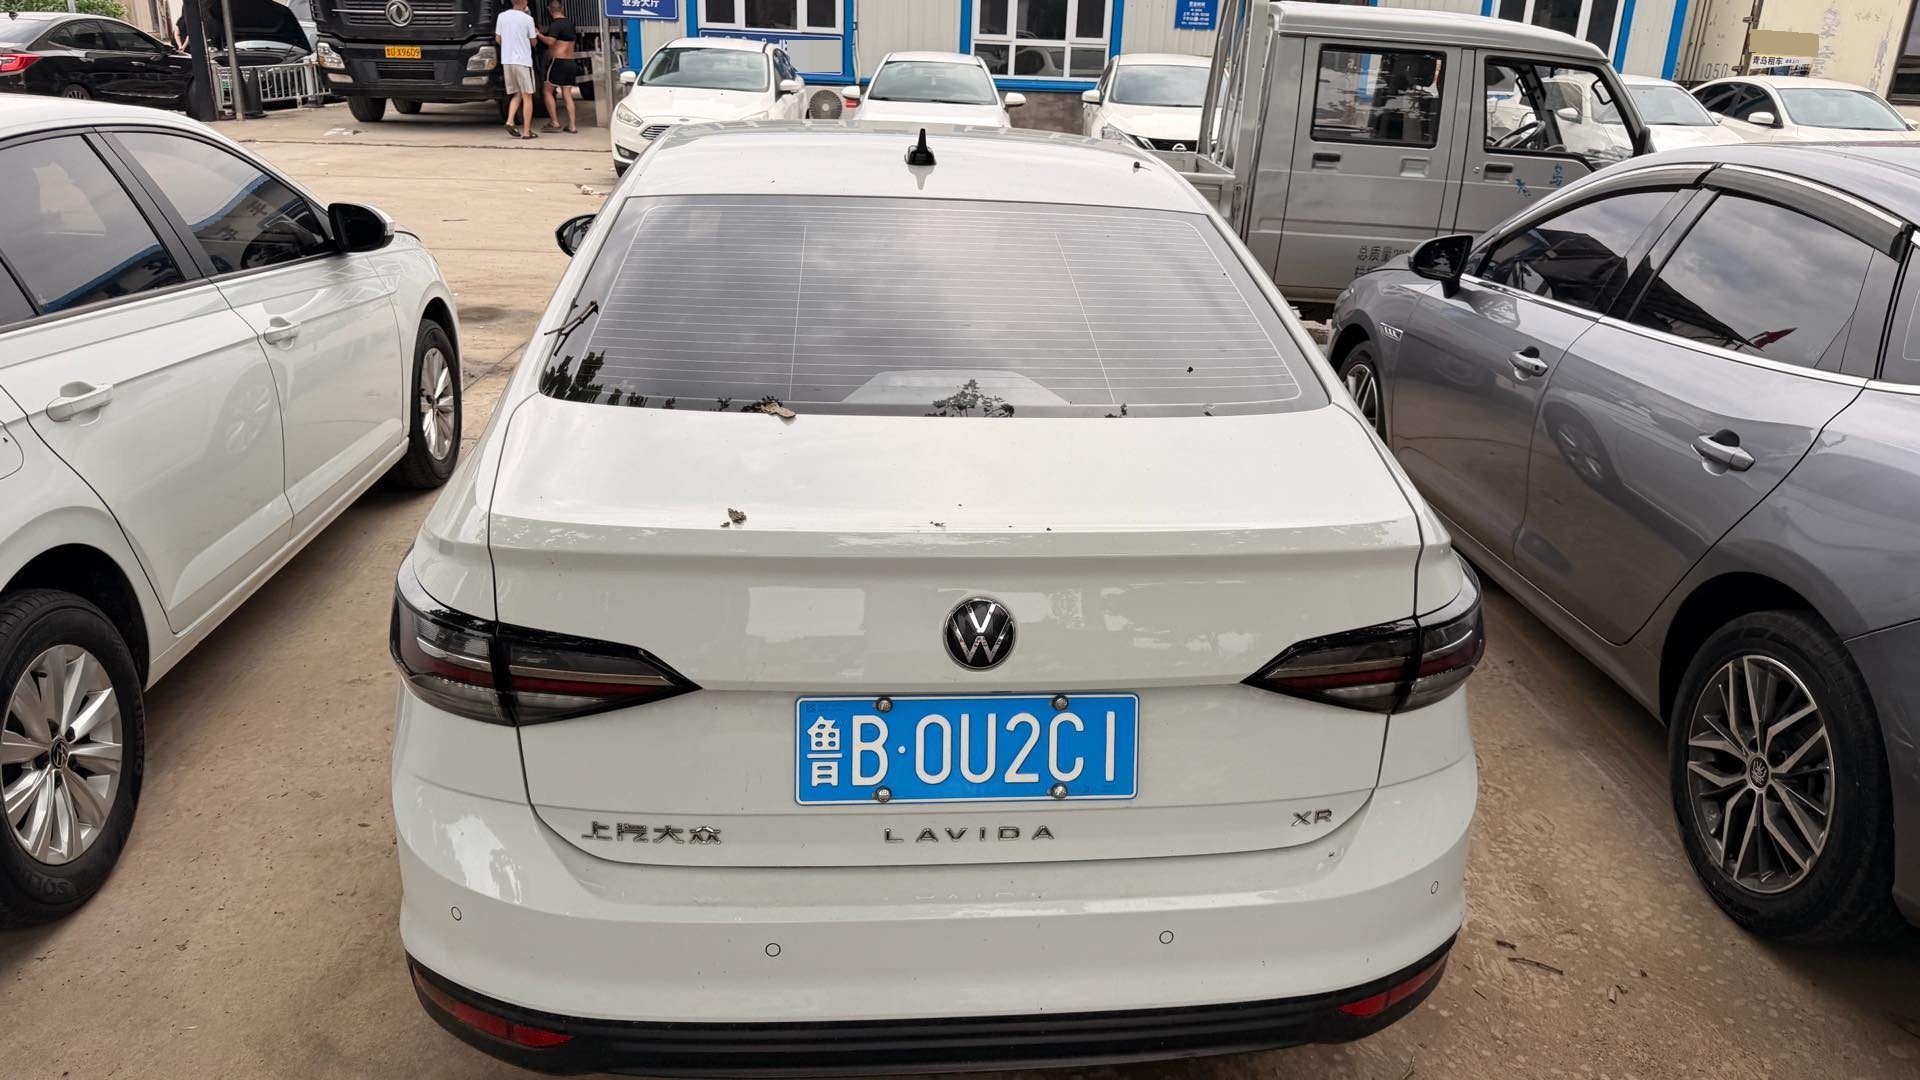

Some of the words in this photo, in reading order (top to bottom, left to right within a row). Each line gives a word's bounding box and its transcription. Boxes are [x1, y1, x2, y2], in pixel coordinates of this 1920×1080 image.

[1752, 55, 1783, 66] 青岛租车
[1291, 809, 1332, 826] XR
[581, 821, 722, 844] 上汽大众
[884, 825, 1055, 843] LAVIDA
